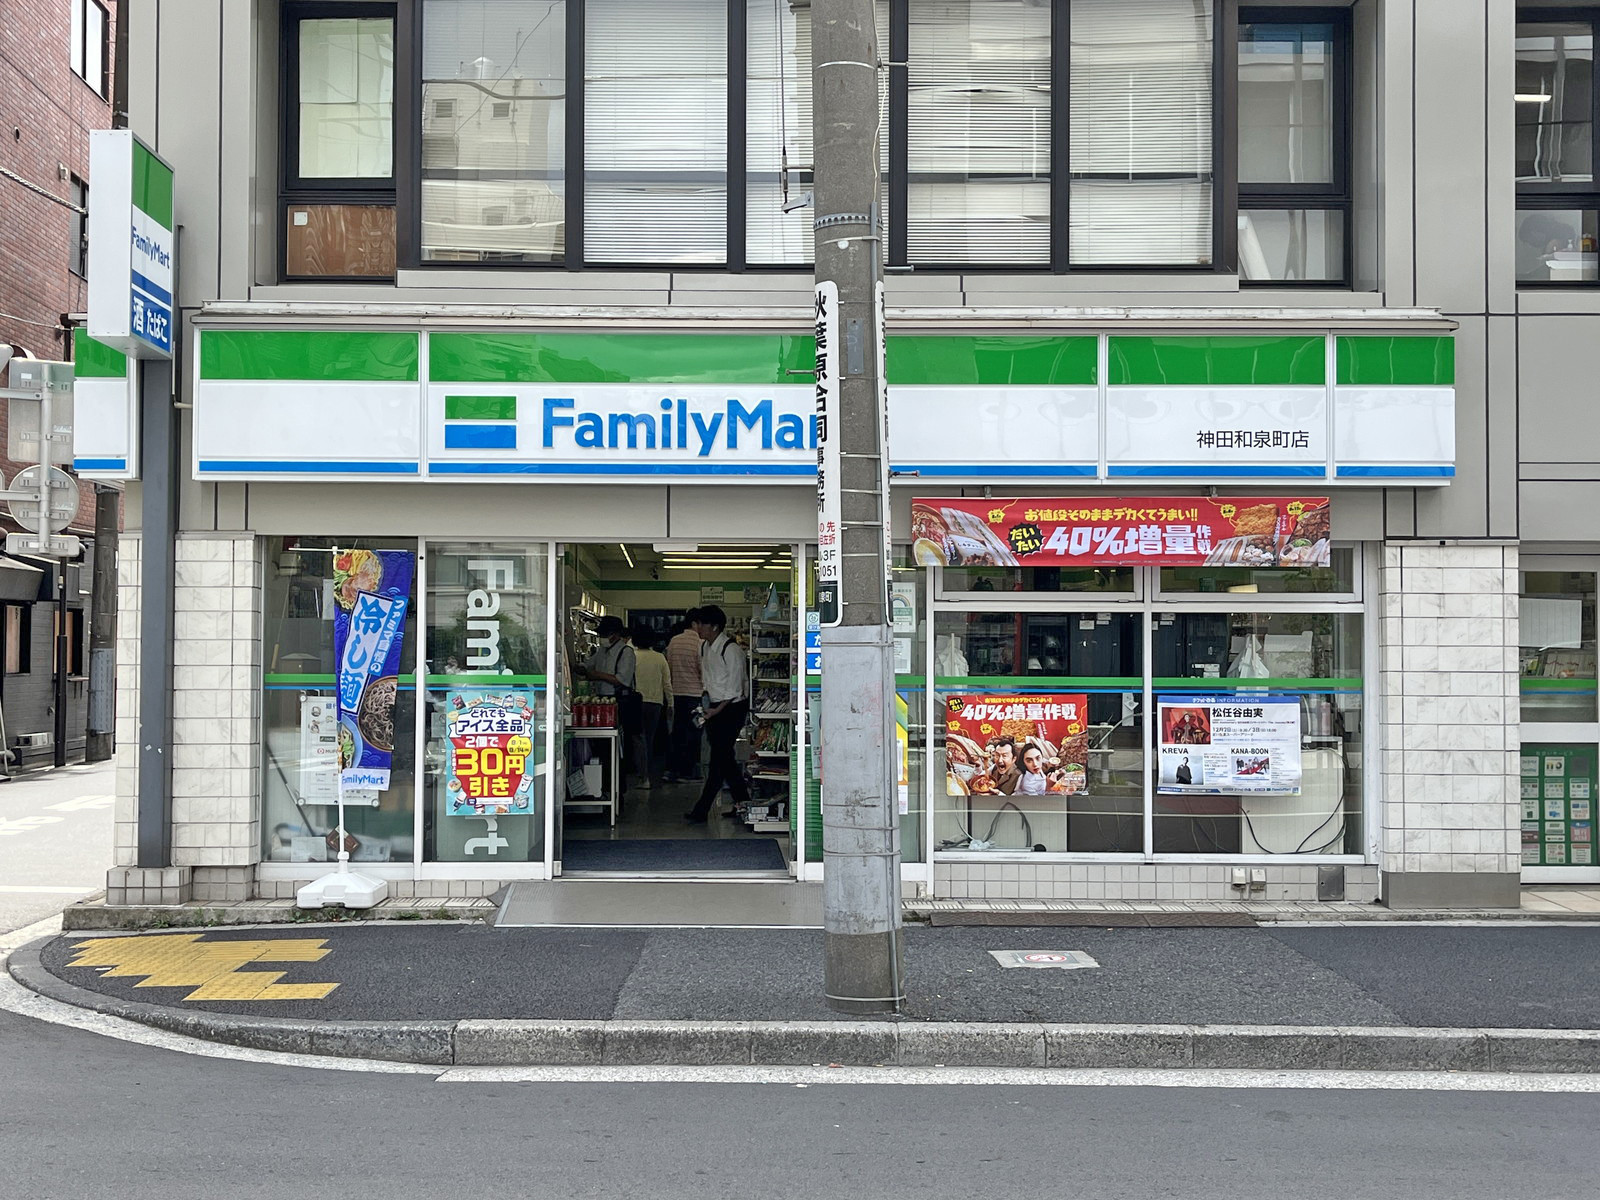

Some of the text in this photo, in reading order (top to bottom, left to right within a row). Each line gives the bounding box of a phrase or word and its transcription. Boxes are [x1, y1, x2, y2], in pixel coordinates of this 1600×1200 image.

[131, 225, 170, 269] FamilyMart
[133, 295, 168, 344] 酒 たばこ
[1196, 430, 1310, 449] 神田和泉町店
[470, 709, 506, 718] どれでも
[961, 703, 1078, 720] 40%増量作戦
[1212, 707, 1264, 718] 松任谷由実
[457, 719, 523, 732] アイス全品
[465, 735, 499, 748] 2個で
[456, 748, 525, 776] 30円
[468, 776, 510, 797] 引き
